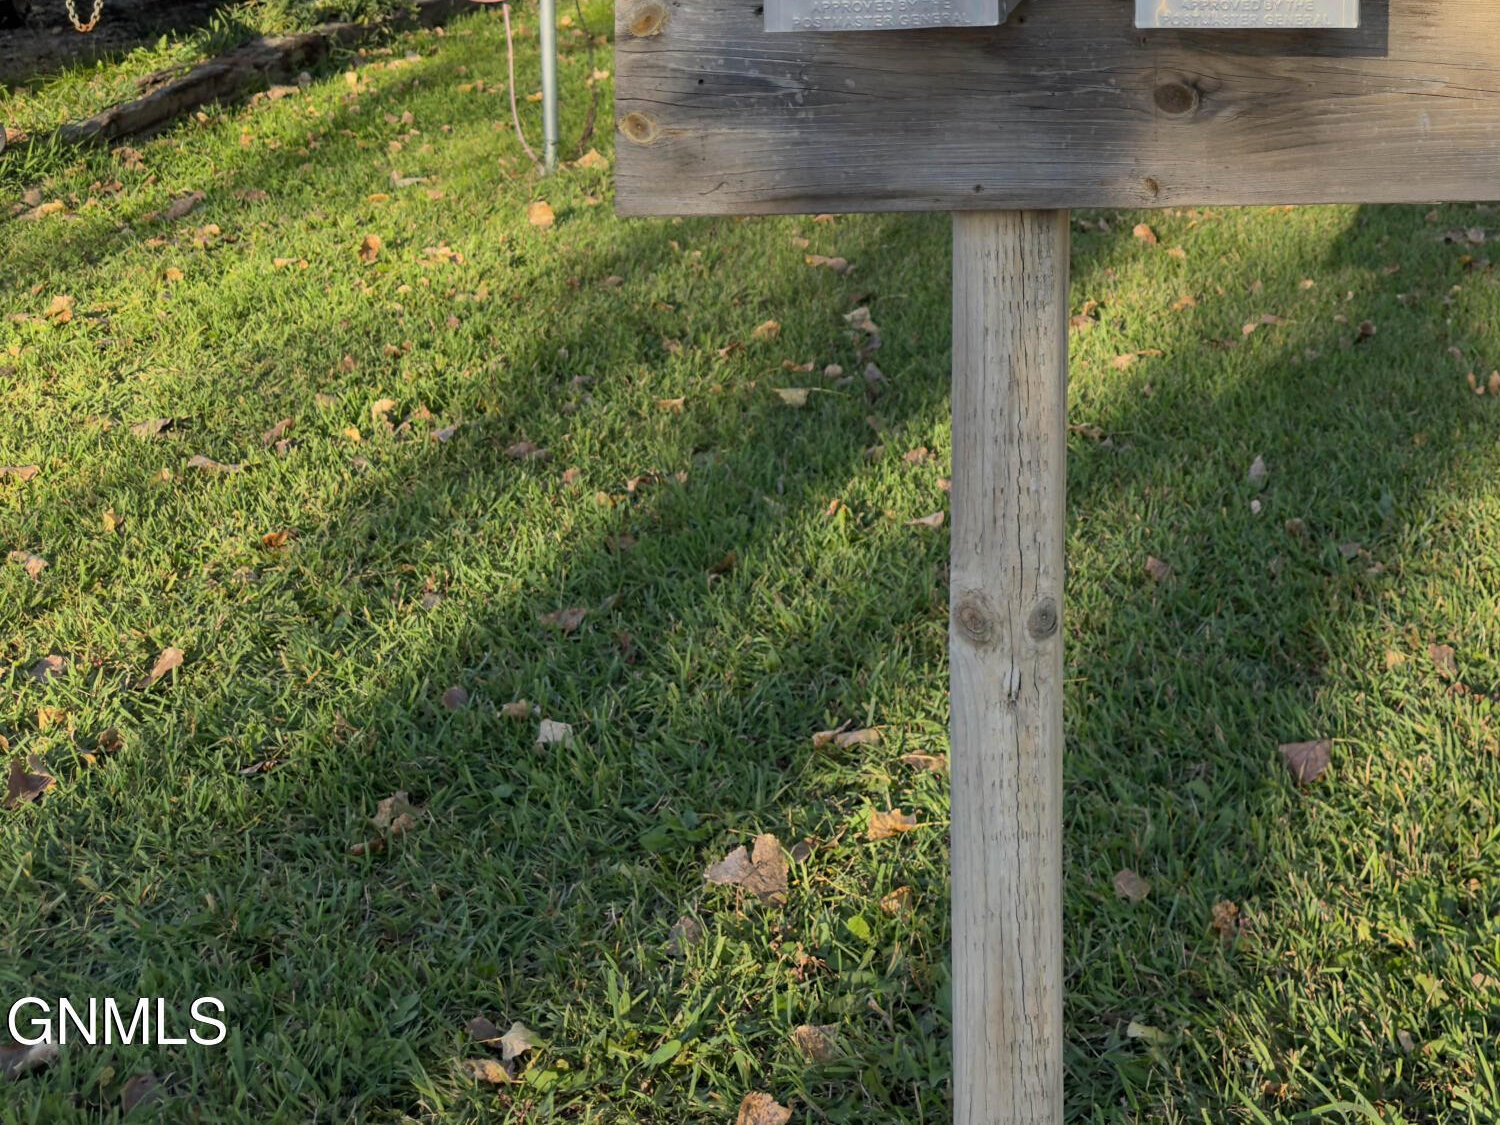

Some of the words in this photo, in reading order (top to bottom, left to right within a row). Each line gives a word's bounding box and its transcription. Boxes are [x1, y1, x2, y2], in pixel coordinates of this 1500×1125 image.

[812, 0, 894, 14] APPROVED
[1181, 0, 1260, 13] APPROVED
[1263, 0, 1283, 13] BY
[1286, 0, 1315, 13] THE
[792, 15, 894, 29] POSTMASTER
[899, 12, 972, 27] GENERAL
[1263, 13, 1332, 27] GENERAL
